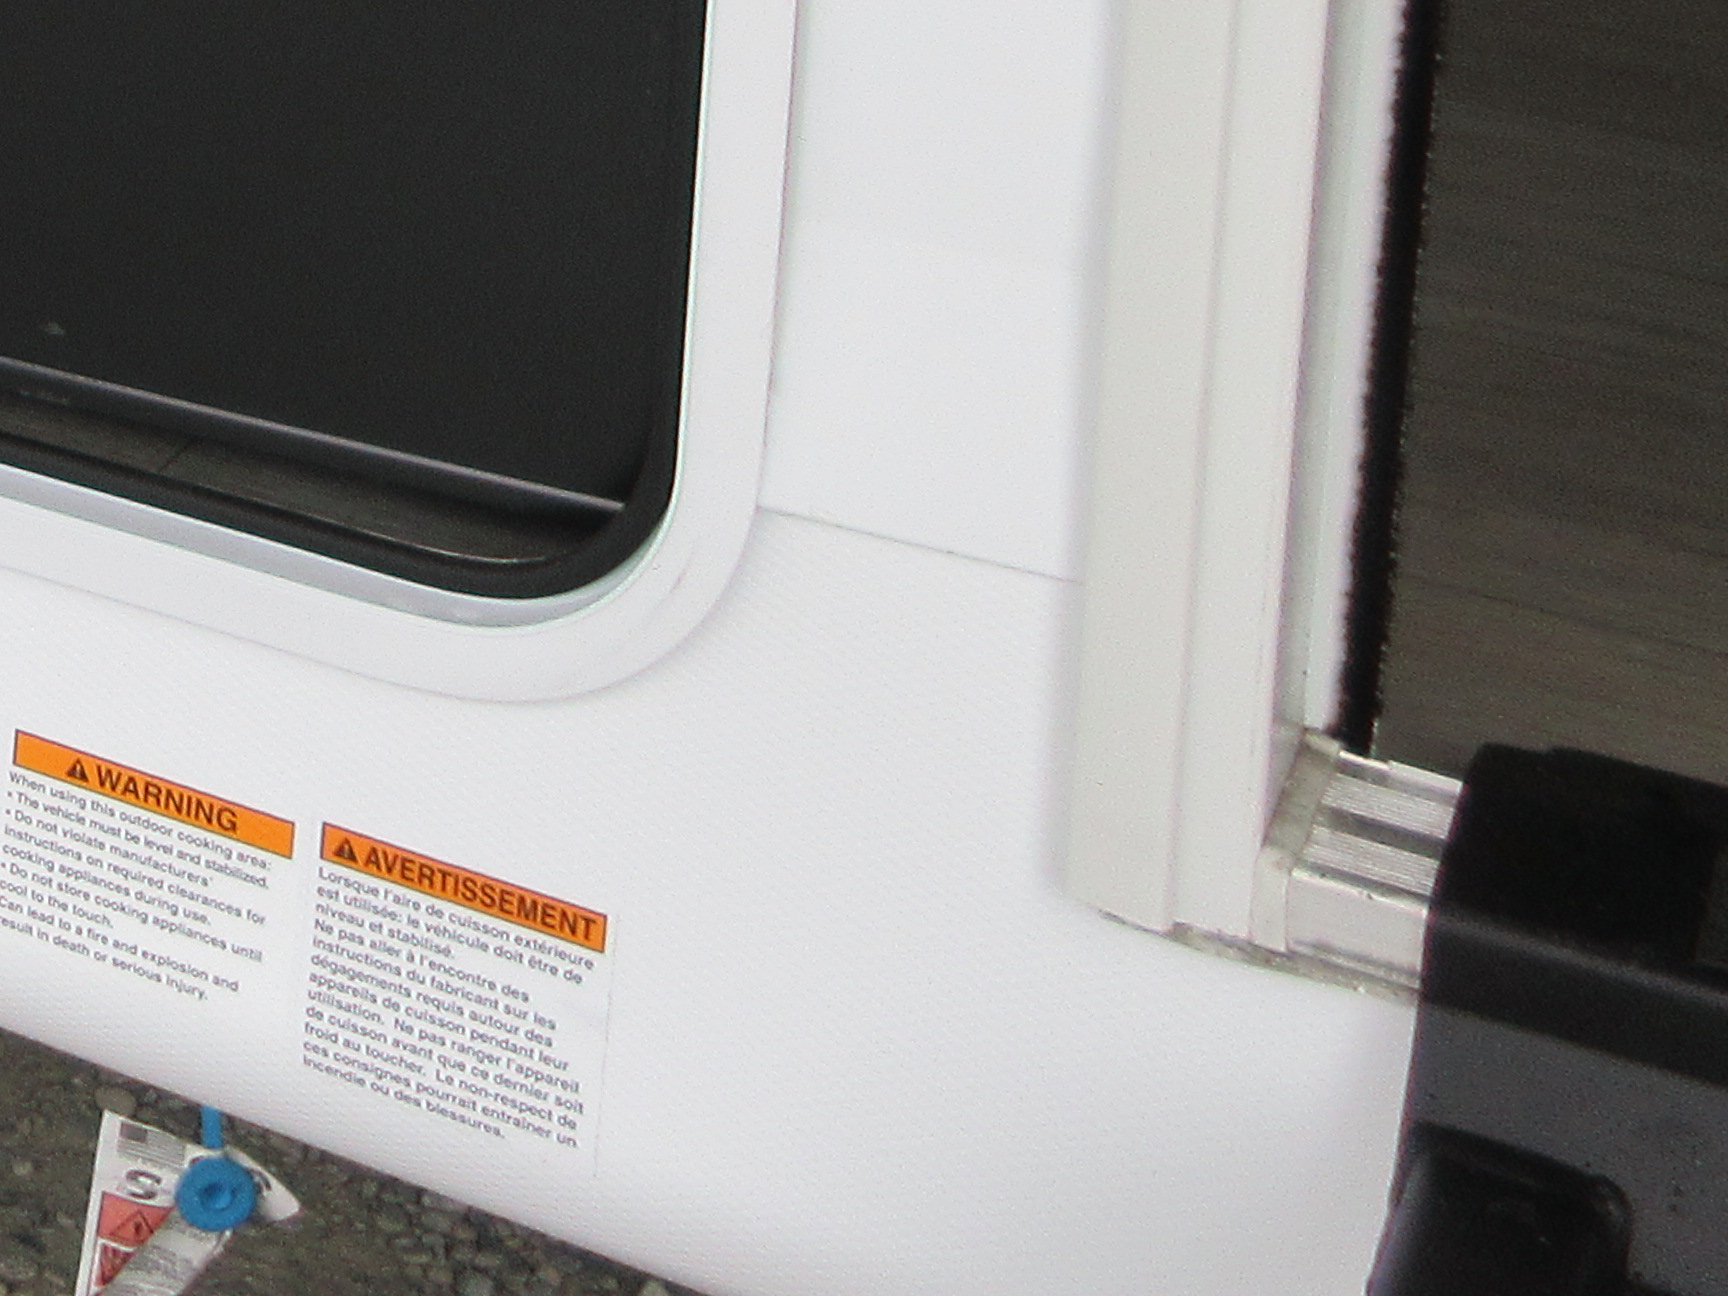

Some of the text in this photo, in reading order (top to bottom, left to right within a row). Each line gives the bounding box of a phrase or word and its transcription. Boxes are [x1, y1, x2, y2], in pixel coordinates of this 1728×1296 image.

[9, 771, 45, 793] When
[50, 787, 86, 810] using
[90, 799, 115, 817] this
[119, 811, 172, 836] outdoor
[177, 831, 232, 860] cooking
[14, 809, 32, 825] Do
[35, 819, 57, 835] not
[61, 827, 105, 851] violate
[17, 791, 38, 809] The
[42, 803, 85, 825] vehicle
[89, 819, 120, 837] must
[124, 829, 140, 844] be
[144, 835, 172, 855] level
[176, 850, 200, 865] and
[96, 763, 238, 834] WARNING
[0, 879, 27, 897] cool
[31, 889, 44, 903] to
[47, 895, 68, 912] the
[2, 844, 54, 872] cooking
[58, 863, 130, 896] appliances
[134, 890, 178, 916] during
[4, 824, 265, 924] instructions on required clearances for
[9, 862, 261, 961] Do not store cooking appliances until
[318, 866, 380, 899] Lorsque
[424, 903, 444, 919] de
[448, 912, 510, 942] cuisson
[513, 934, 594, 970] extérieure
[364, 845, 597, 942] AVERTISSEMENT
[26, 904, 54, 926] lead
[58, 917, 71, 931] to
[86, 927, 108, 945] fire
[112, 939, 137, 956] and
[141, 949, 208, 981] explosion
[211, 975, 238, 992] and
[37, 927, 48, 941] in
[52, 935, 89, 956] death
[93, 951, 107, 961] or
[112, 957, 161, 982] serious
[314, 918, 334, 935] Ne
[337, 928, 364, 946] pas
[369, 939, 402, 958] aller
[500, 984, 529, 1003] des
[315, 903, 364, 927] niveau
[368, 921, 382, 934] et
[316, 886, 339, 902] est
[406, 913, 420, 929] le
[493, 945, 523, 964] doit
[563, 969, 582, 984] de
[309, 972, 568, 1070] appareils de cuisson pendant leur
[312, 935, 556, 1030] instructions du fabricant sur les
[416, 992, 464, 1017] requis
[468, 1010, 519, 1035] autour
[524, 1028, 552, 1047] des
[303, 1054, 365, 1087] incendie
[370, 1081, 389, 1096] ou
[393, 1089, 421, 1109] des
[304, 1021, 338, 1044] froid
[342, 1038, 361, 1052] au
[435, 1068, 454, 1086] Le
[557, 1114, 576, 1129] de
[305, 1006, 583, 1114] de cuisson avant que ce dernier soit
[393, 1017, 414, 1036] Ne
[417, 1028, 446, 1047] pas
[450, 1039, 502, 1066] ranger
[303, 1041, 328, 1057] ces
[333, 1052, 411, 1088] consignes
[415, 1081, 476, 1111] pourrait
[556, 1133, 576, 1147] un
